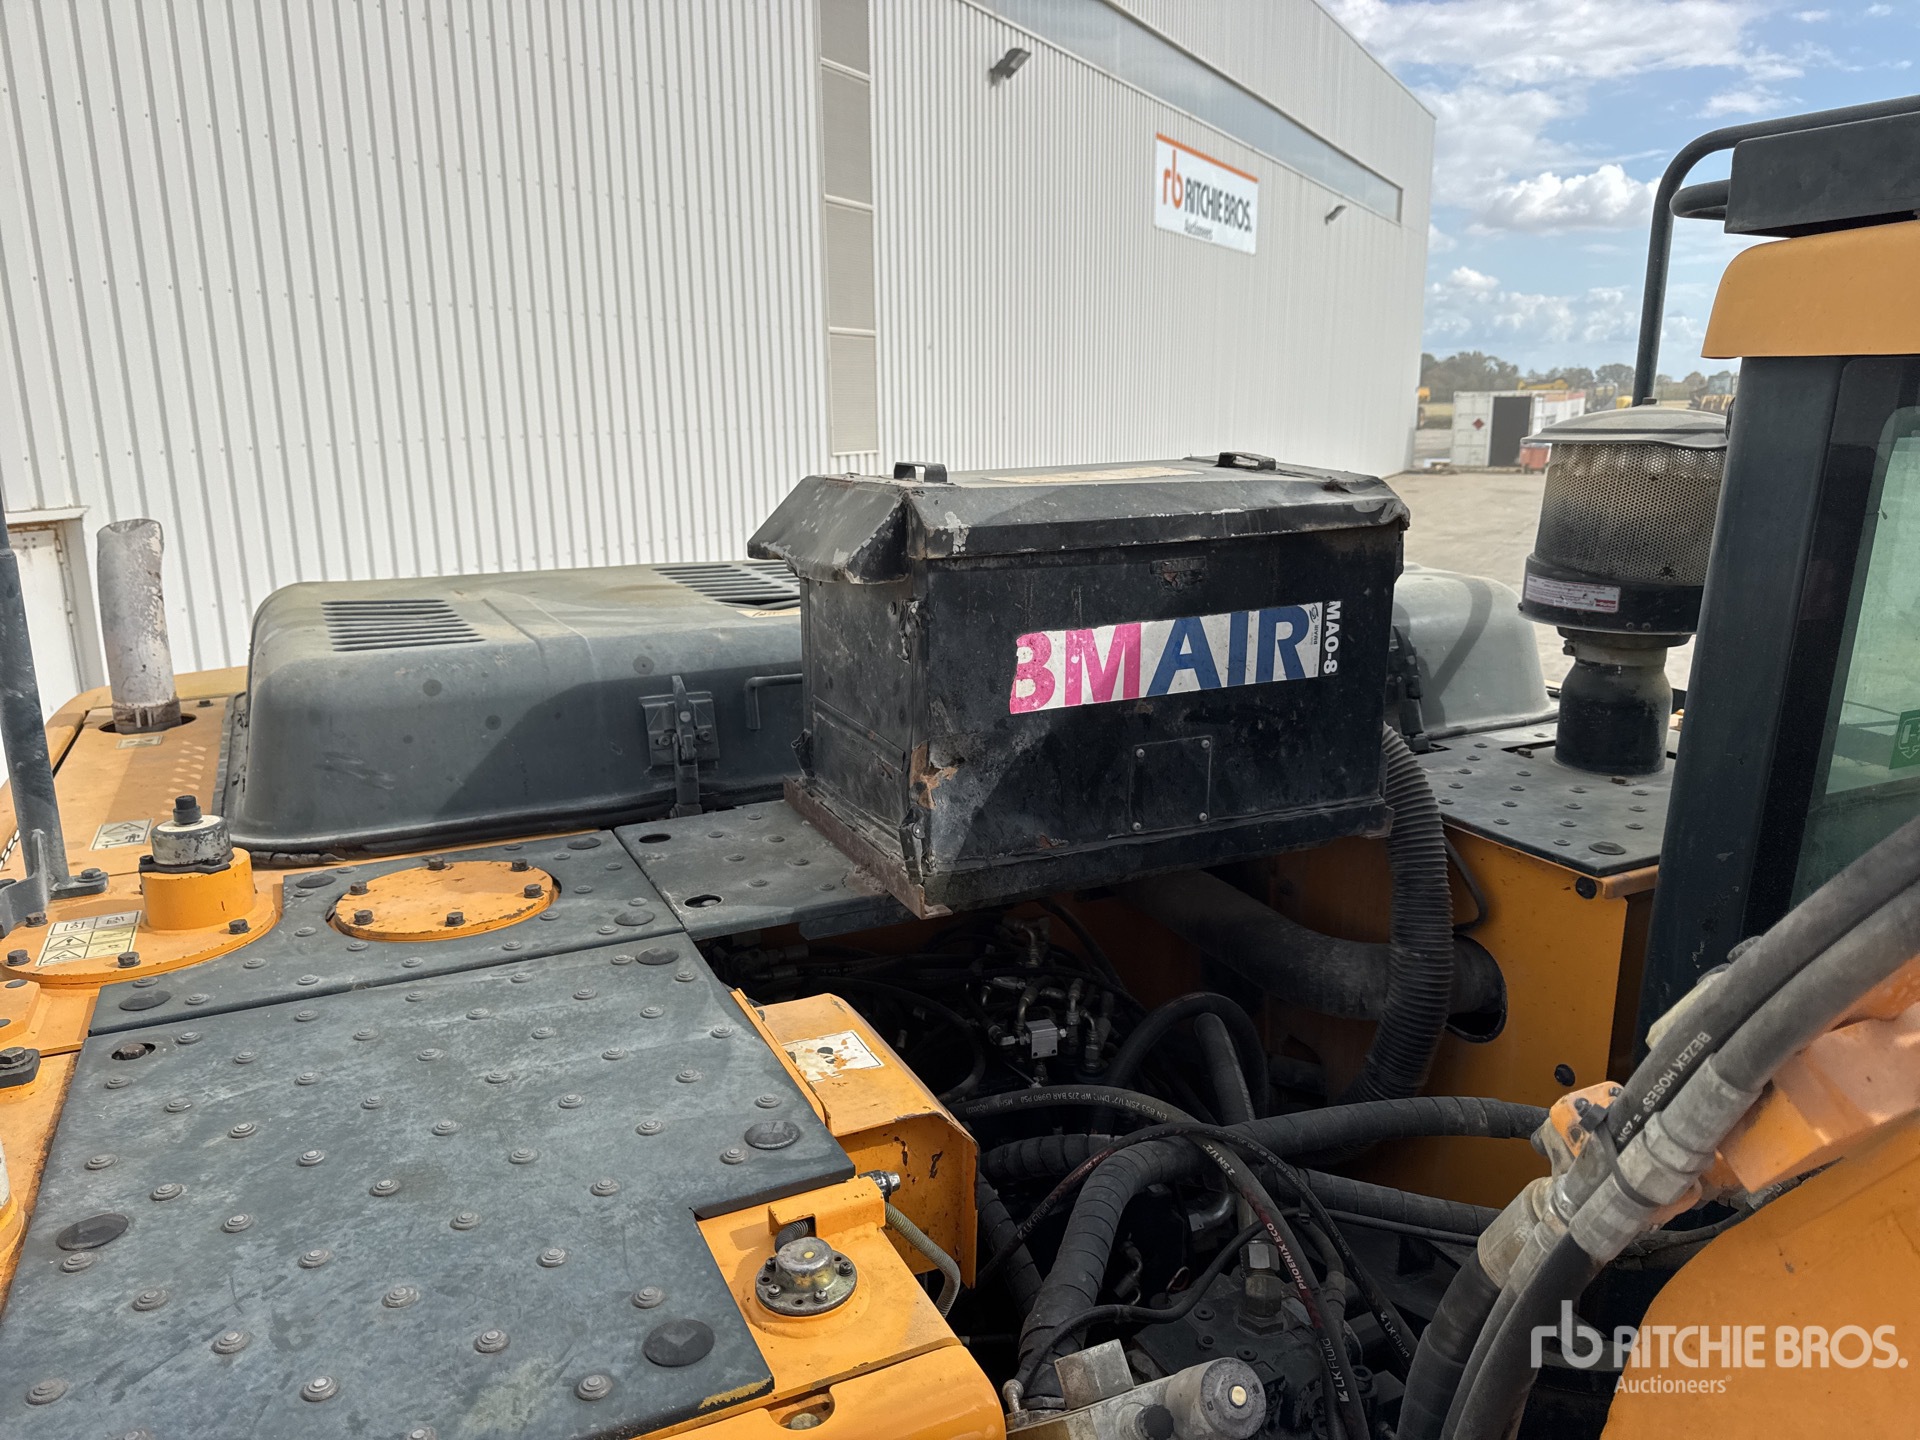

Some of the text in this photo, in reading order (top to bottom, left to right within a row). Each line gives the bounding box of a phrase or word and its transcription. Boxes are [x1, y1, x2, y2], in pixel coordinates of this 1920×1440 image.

[1184, 177, 1223, 223] RITCHIE
[1324, 601, 1341, 674] MAO-8
[1672, 1031, 1712, 1071] BEZEK
[1052, 1092, 1067, 1100] BAR
[1156, 1111, 1167, 1121] EN
[1217, 1157, 1231, 1173] SN
[1266, 1222, 1307, 1290] PHOENIX ECO
[1322, 1338, 1345, 1387] LK Fluid
